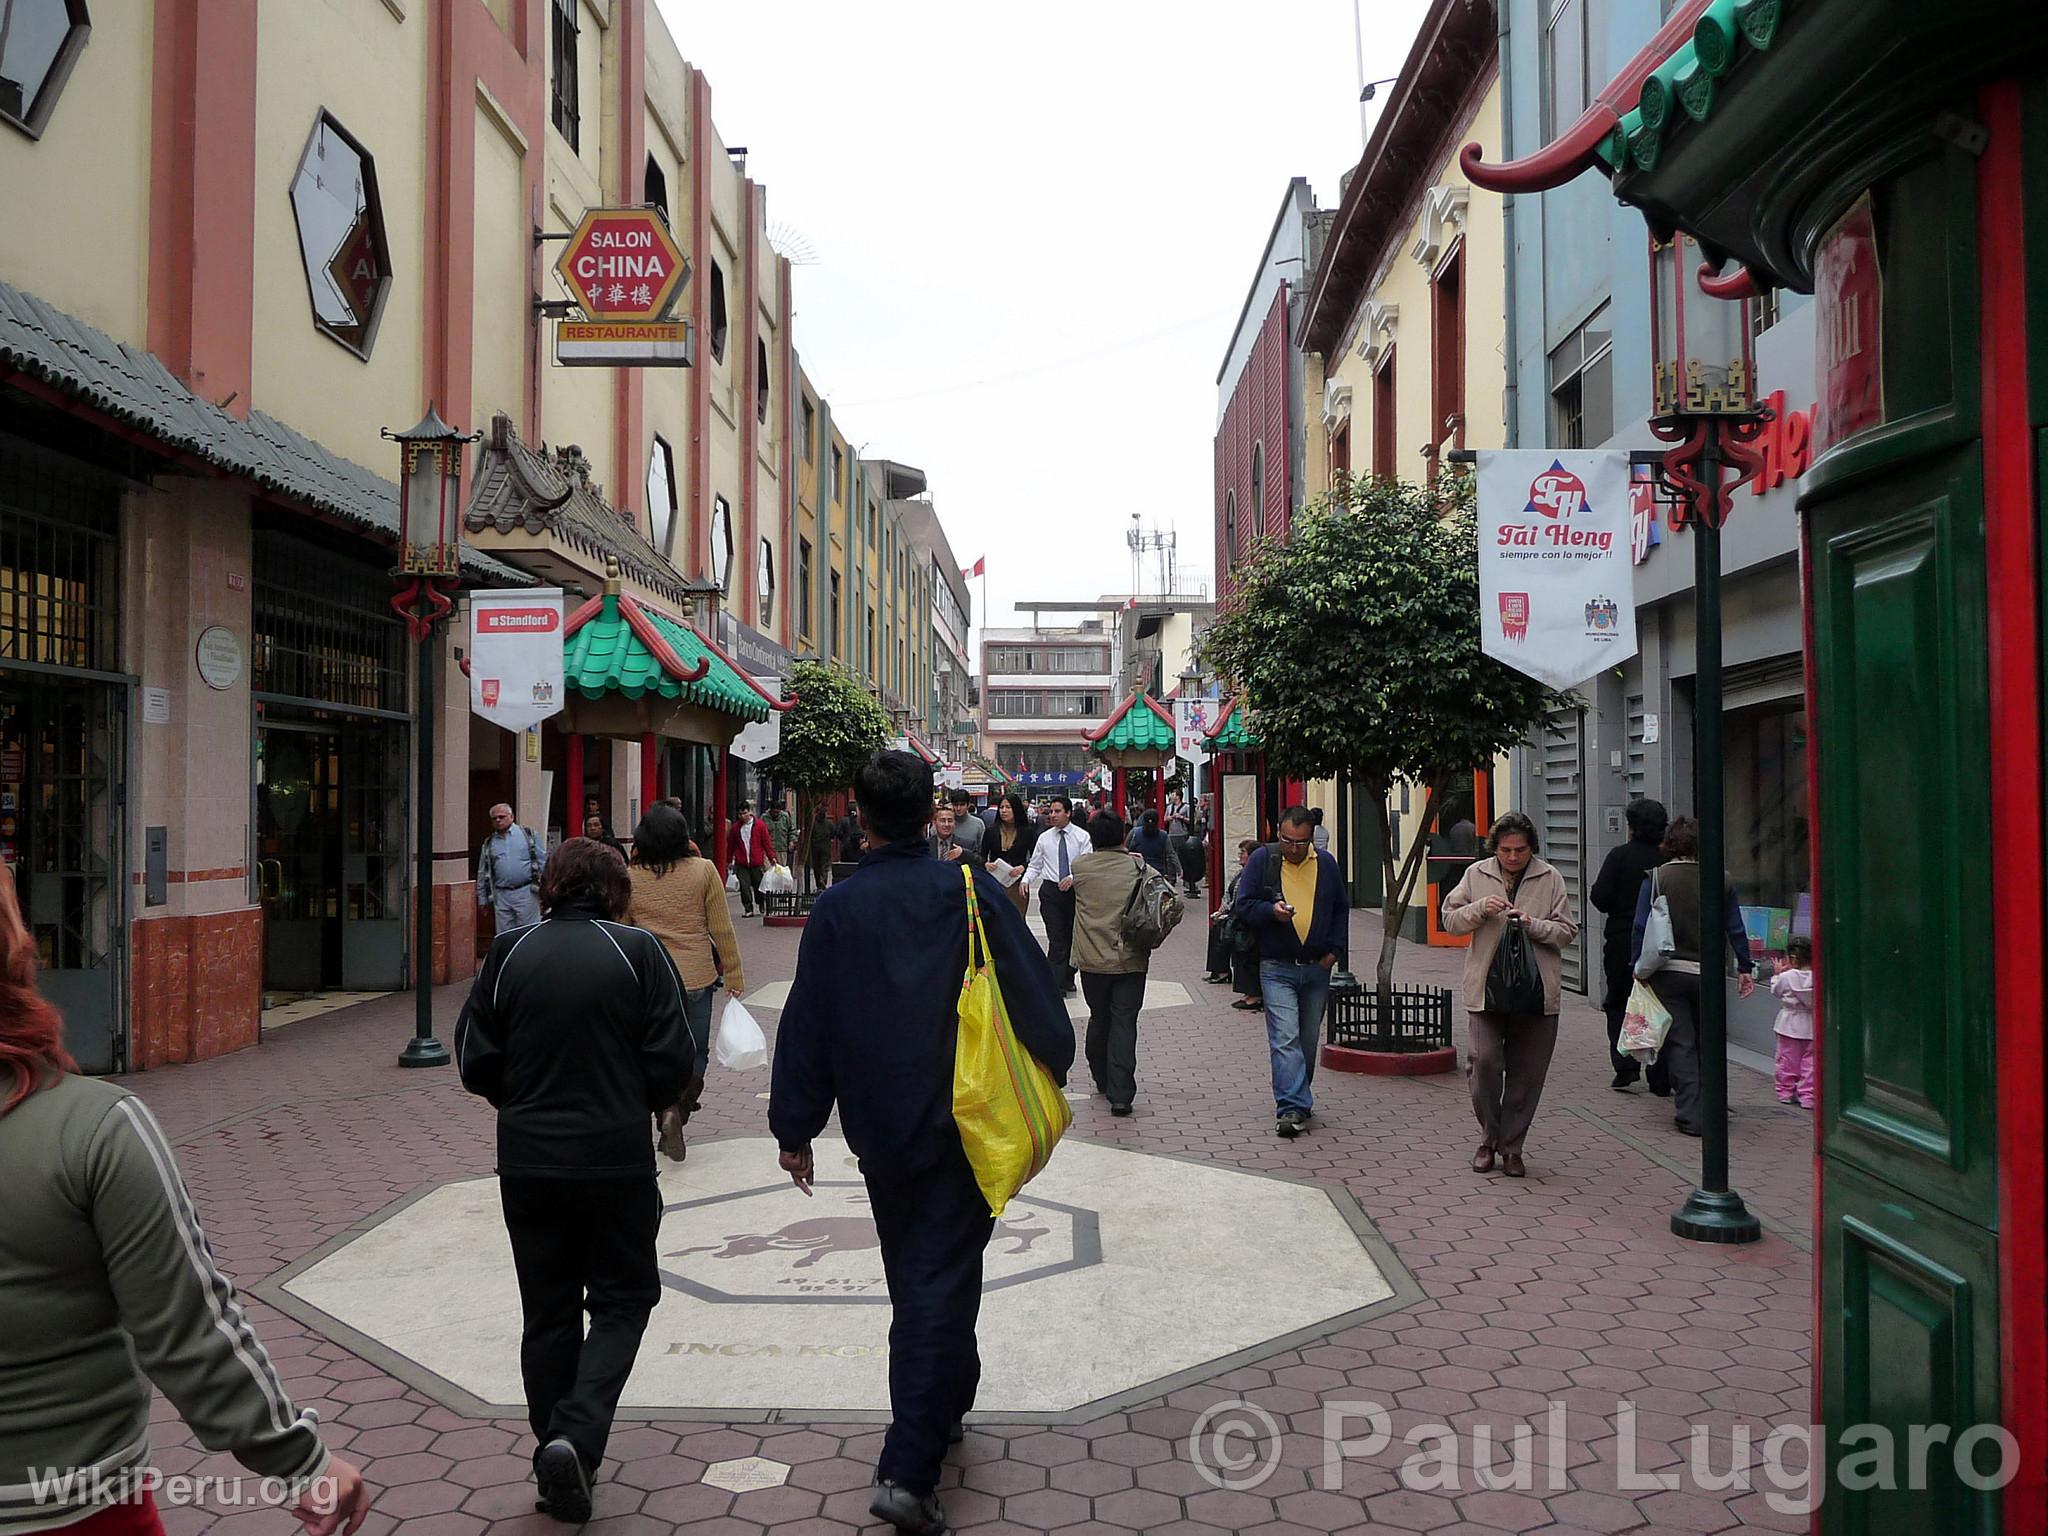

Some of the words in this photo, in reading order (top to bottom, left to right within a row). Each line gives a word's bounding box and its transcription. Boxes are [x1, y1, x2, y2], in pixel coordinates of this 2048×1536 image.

[590, 231, 651, 248] SALON
[577, 255, 665, 278] CHINA
[586, 283, 652, 306] 中華樓
[566, 327, 677, 339] RESTAURANTE
[1497, 525, 1538, 546] Tai
[1544, 524, 1613, 551] Heng
[1499, 551, 1539, 560] siempre
[1563, 551, 1572, 559] lo
[499, 614, 549, 627] Standford
[664, 1343, 782, 1357] INCA
